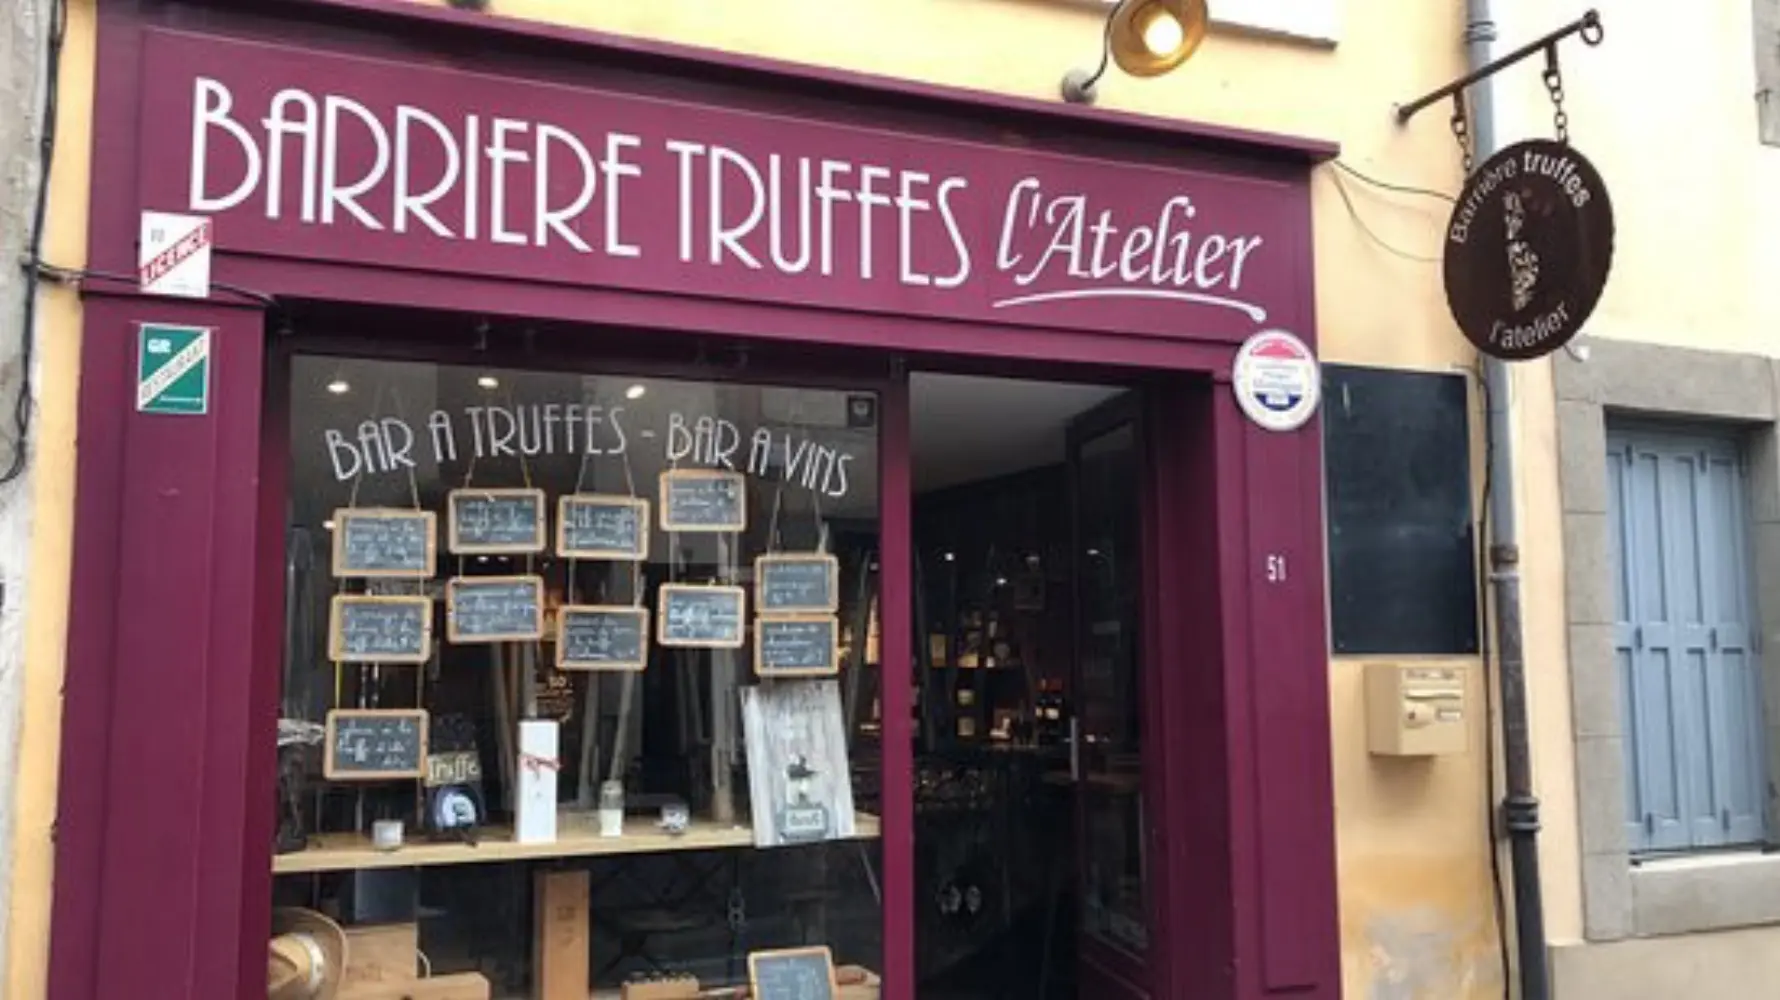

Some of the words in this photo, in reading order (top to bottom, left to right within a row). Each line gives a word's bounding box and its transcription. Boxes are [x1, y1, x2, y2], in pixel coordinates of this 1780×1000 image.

[190, 77, 641, 257] BARRIERE
[666, 139, 971, 288] TRUFFES
[996, 177, 1263, 292] l'Atelier
[1523, 150, 1593, 208] truffes
[325, 418, 417, 481] BAR
[428, 409, 457, 463] A
[465, 403, 627, 459] TRUFFES
[665, 412, 741, 472] BAR
[748, 428, 774, 476] A
[784, 434, 855, 497] VINS
[1267, 554, 1286, 582] 51
